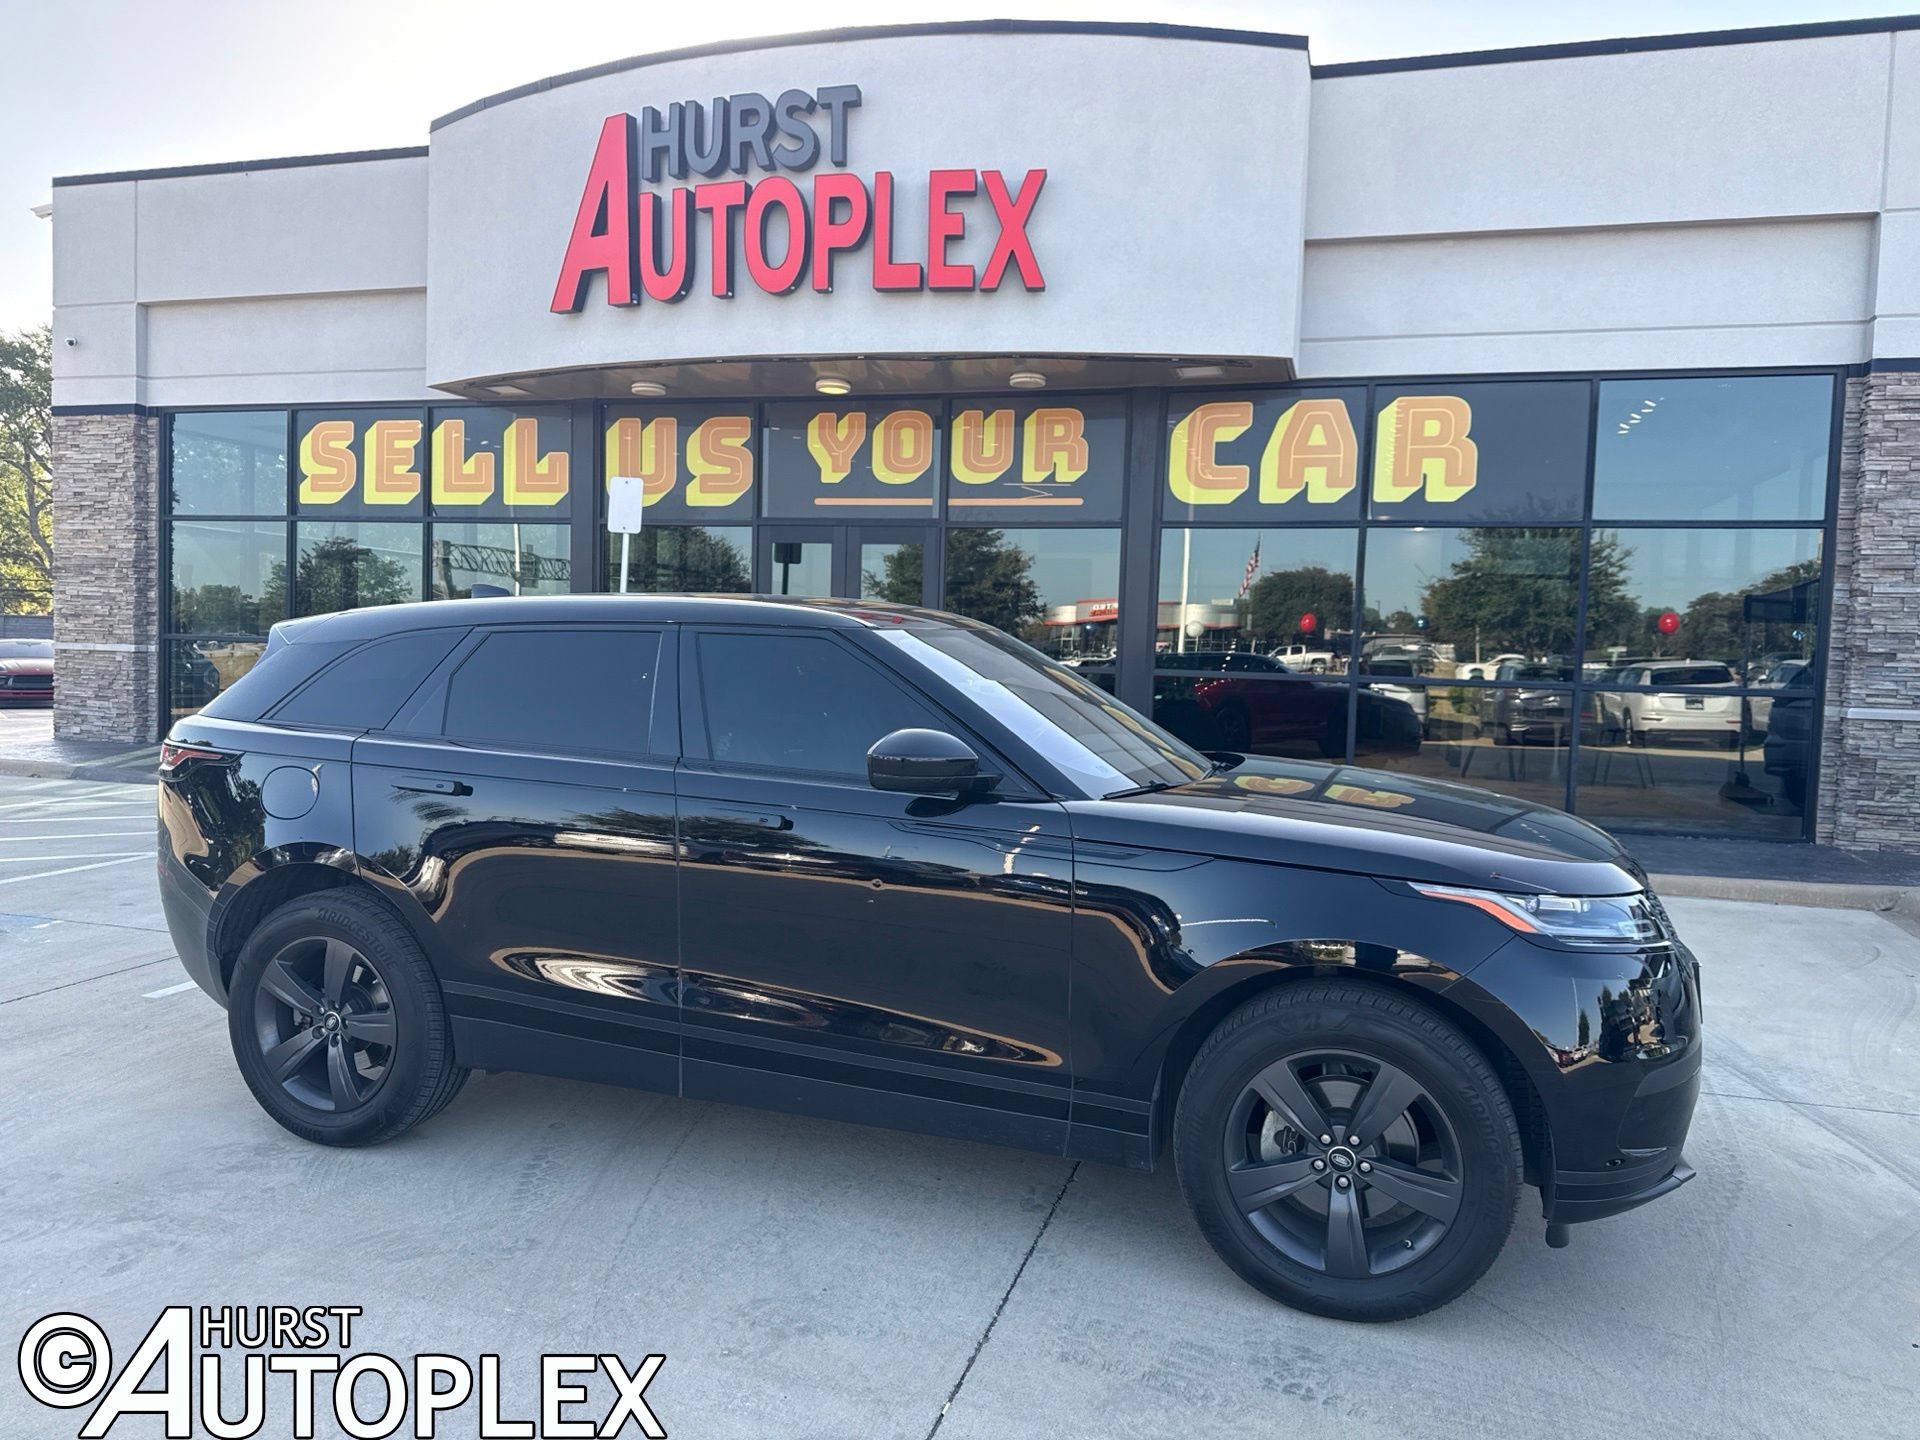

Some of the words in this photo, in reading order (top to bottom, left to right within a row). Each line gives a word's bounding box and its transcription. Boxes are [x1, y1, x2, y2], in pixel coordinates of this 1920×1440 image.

[641, 84, 862, 183] HURST
[550, 112, 1047, 314] AUTOPLEX
[299, 417, 570, 506] SELL
[606, 416, 754, 508] US
[806, 408, 1090, 484] YOUR
[1168, 395, 1479, 505] CAR
[317, 907, 398, 970] BRIDGESTONE
